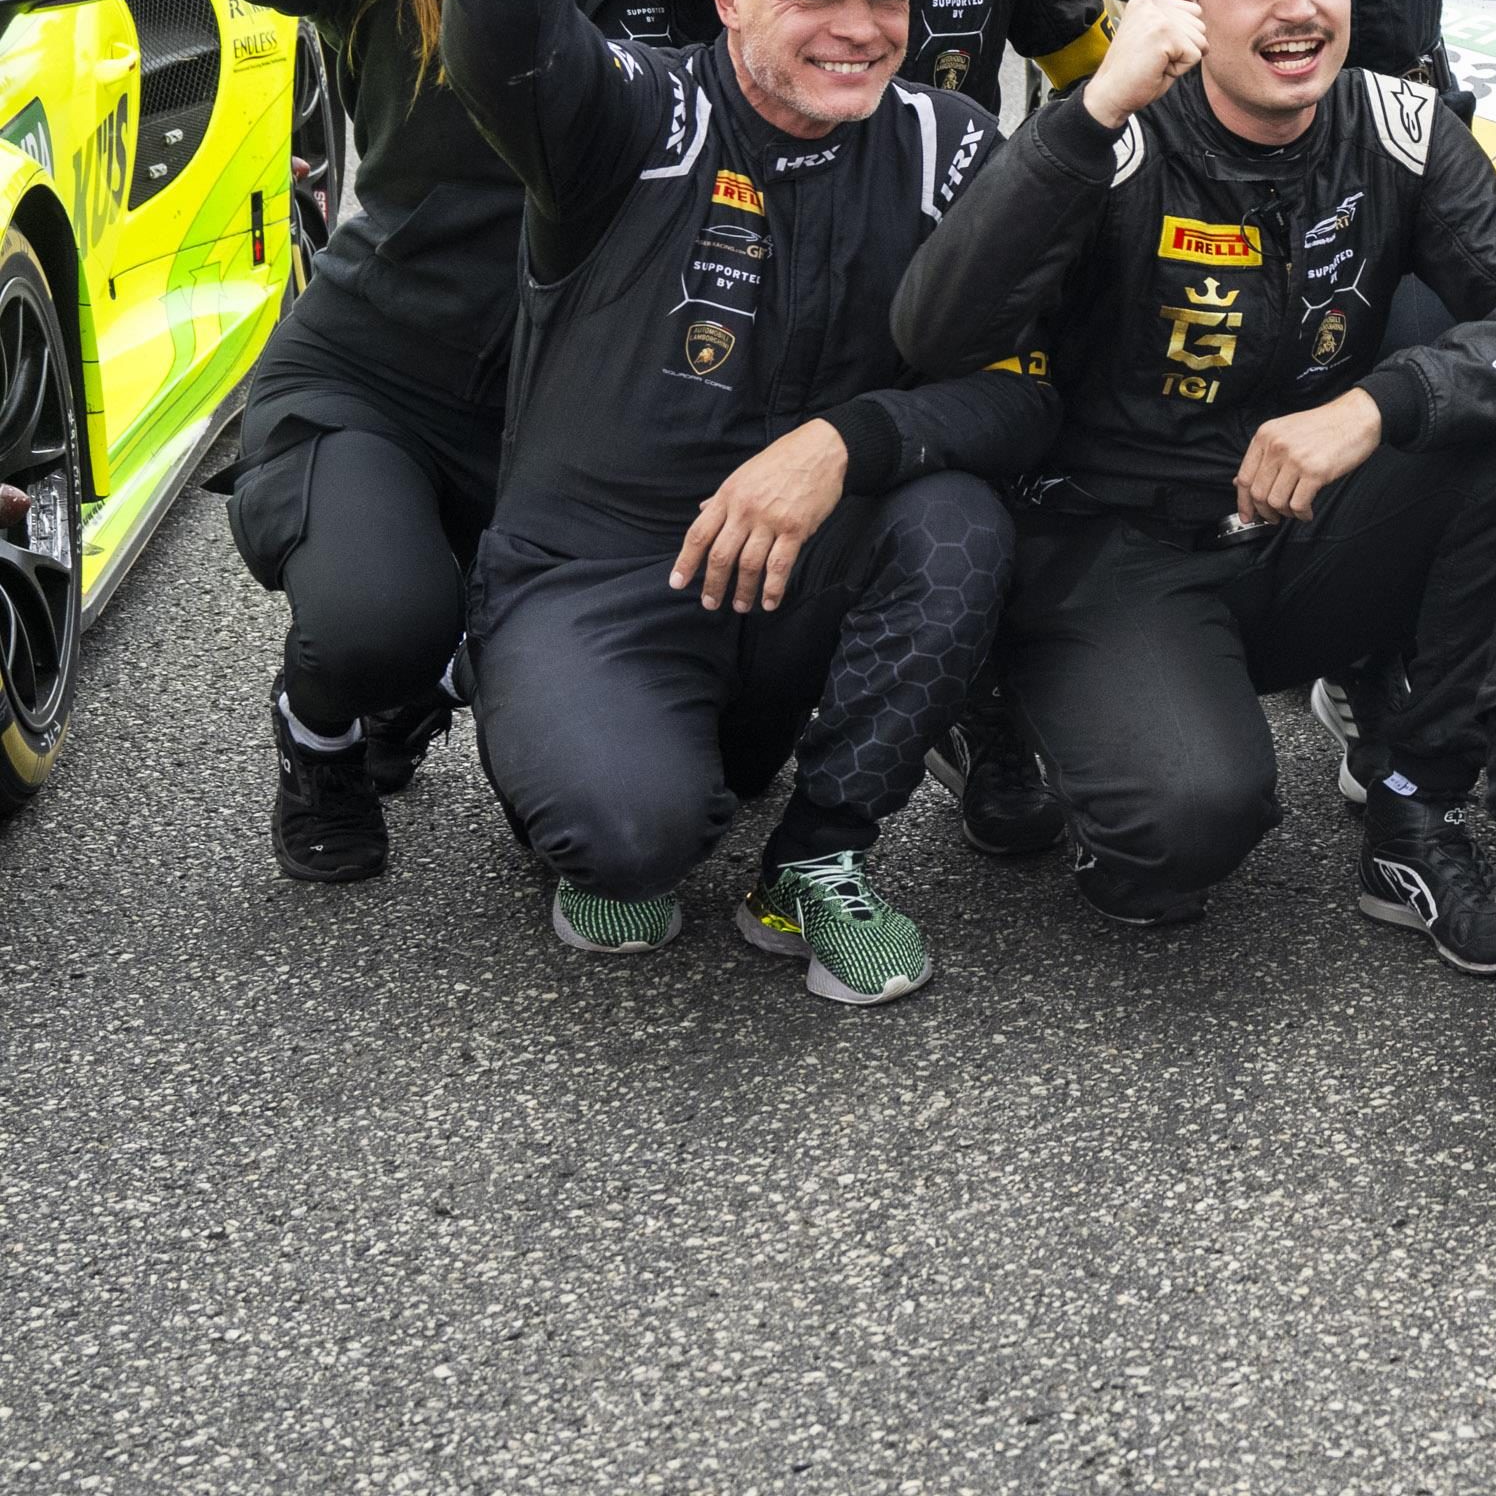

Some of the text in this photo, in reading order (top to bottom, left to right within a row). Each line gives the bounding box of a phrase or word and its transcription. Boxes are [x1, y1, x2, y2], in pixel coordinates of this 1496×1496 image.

[233, 31, 279, 59] ENDLESS
[775, 144, 842, 172] HRX
[940, 118, 985, 203] HRX
[1172, 226, 1250, 258] PIRELLI
[717, 277, 735, 291] BY
[1160, 373, 1221, 404] TGI
